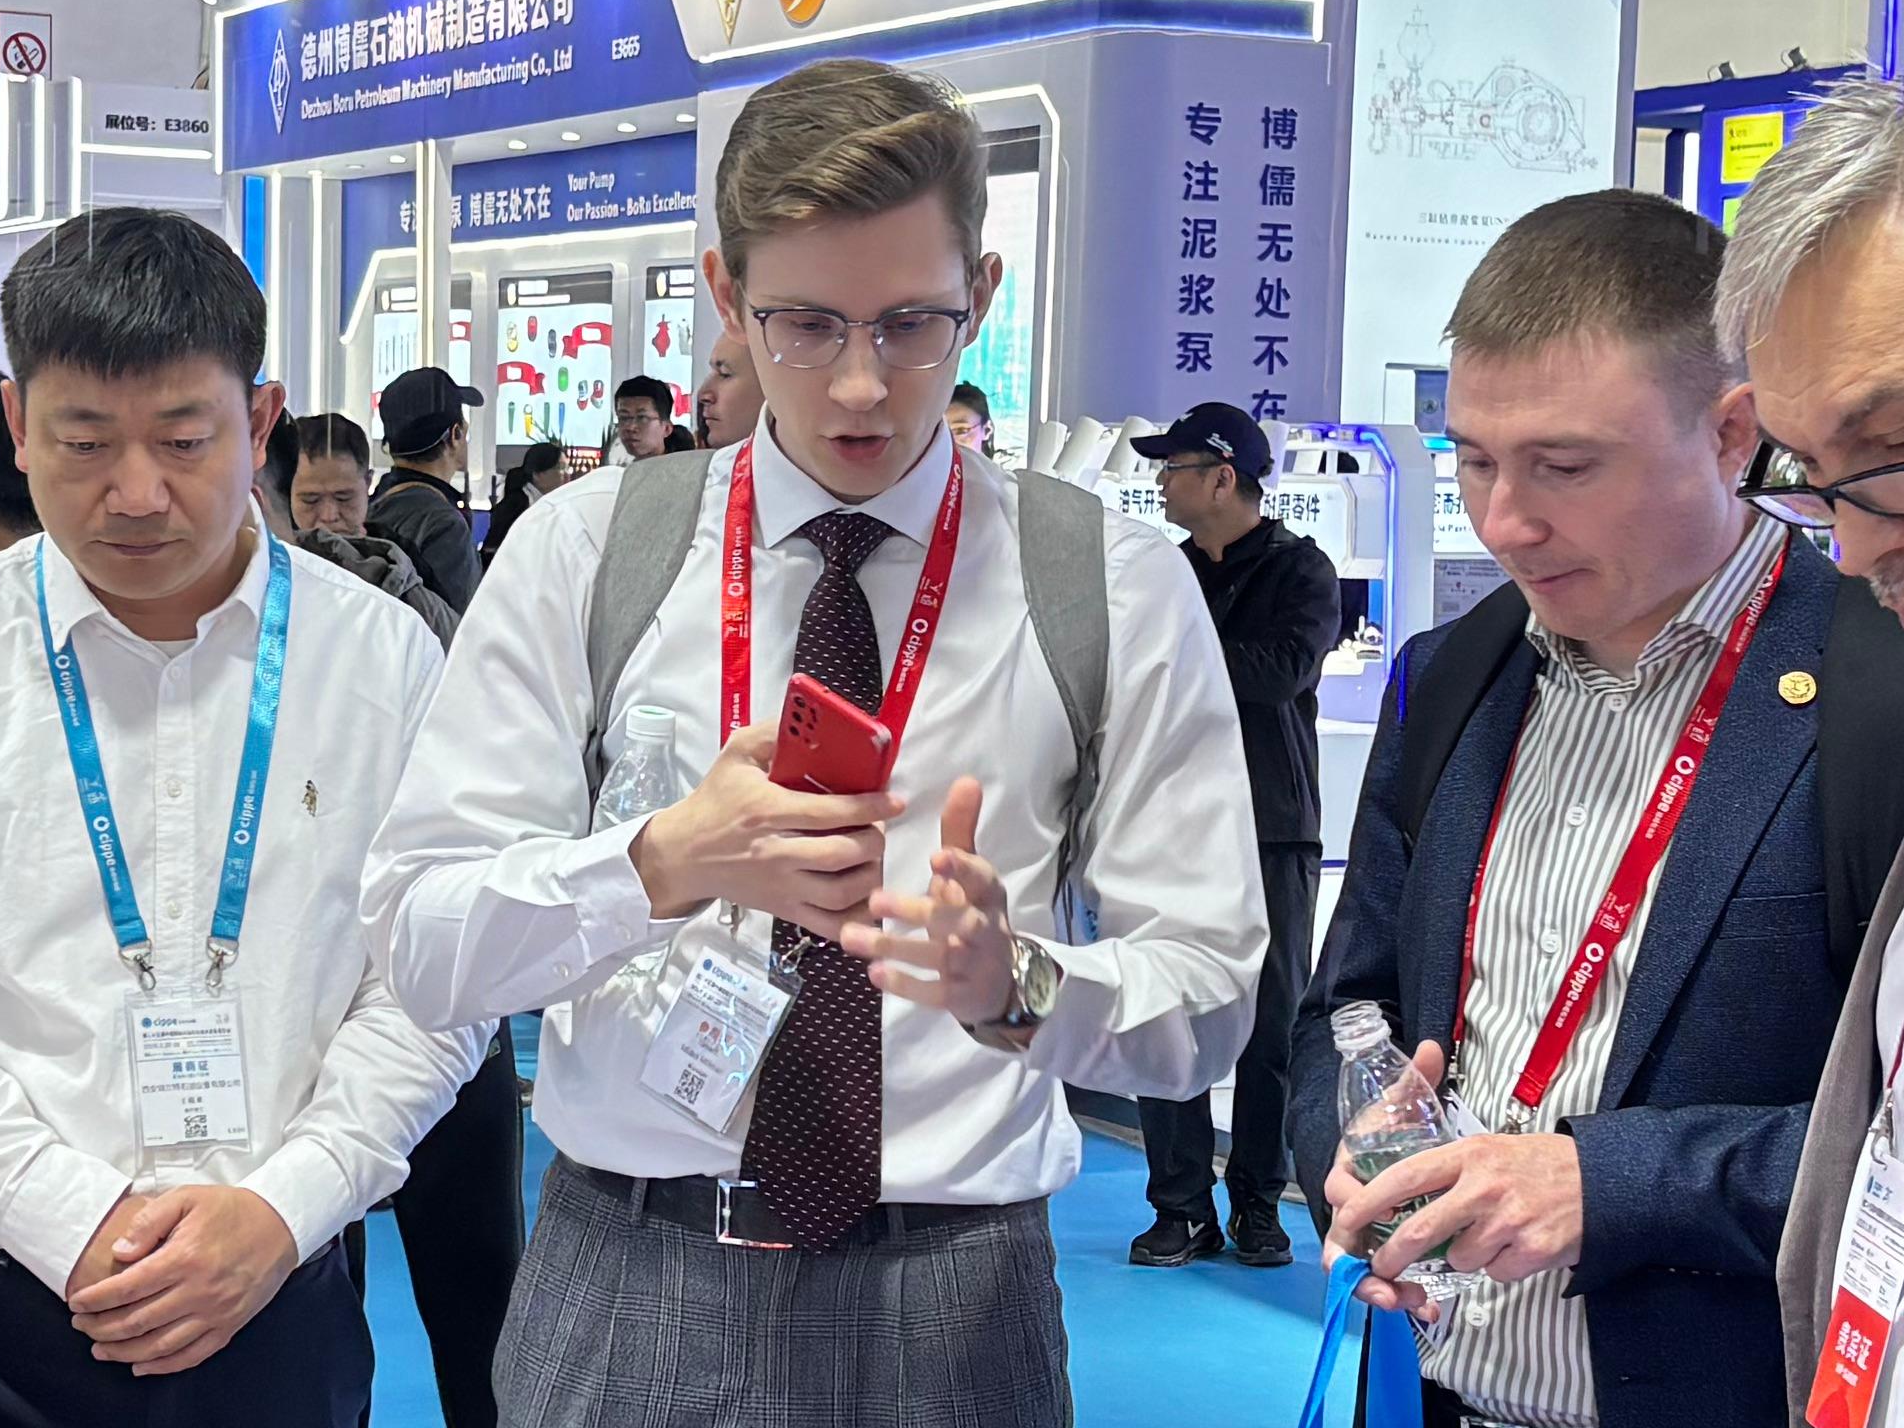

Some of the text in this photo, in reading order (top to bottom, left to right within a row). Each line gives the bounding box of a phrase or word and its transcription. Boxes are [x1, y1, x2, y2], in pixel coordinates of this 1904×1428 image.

[301, 94, 333, 120] Dezhou
[333, 90, 354, 115] Boru
[354, 83, 401, 112] Petroleum
[401, 74, 453, 103] Machinery
[453, 57, 529, 92] Manufacturing
[553, 45, 574, 73] Ltd
[164, 117, 210, 134] E3860
[567, 171, 615, 193] Your Pump
[469, 183, 552, 228] 博儒无处不在
[567, 202, 585, 222] Our
[585, 199, 620, 222] Passion
[1175, 101, 1223, 373] 专注泥浆泵
[1251, 105, 1299, 421] 博儒无处不在
[903, 635, 922, 667] cippe
[60, 671, 76, 709] cippe
[1658, 774, 1684, 813] cippe
[99, 833, 116, 866] cippe
[1567, 962, 1593, 1001] cippe
